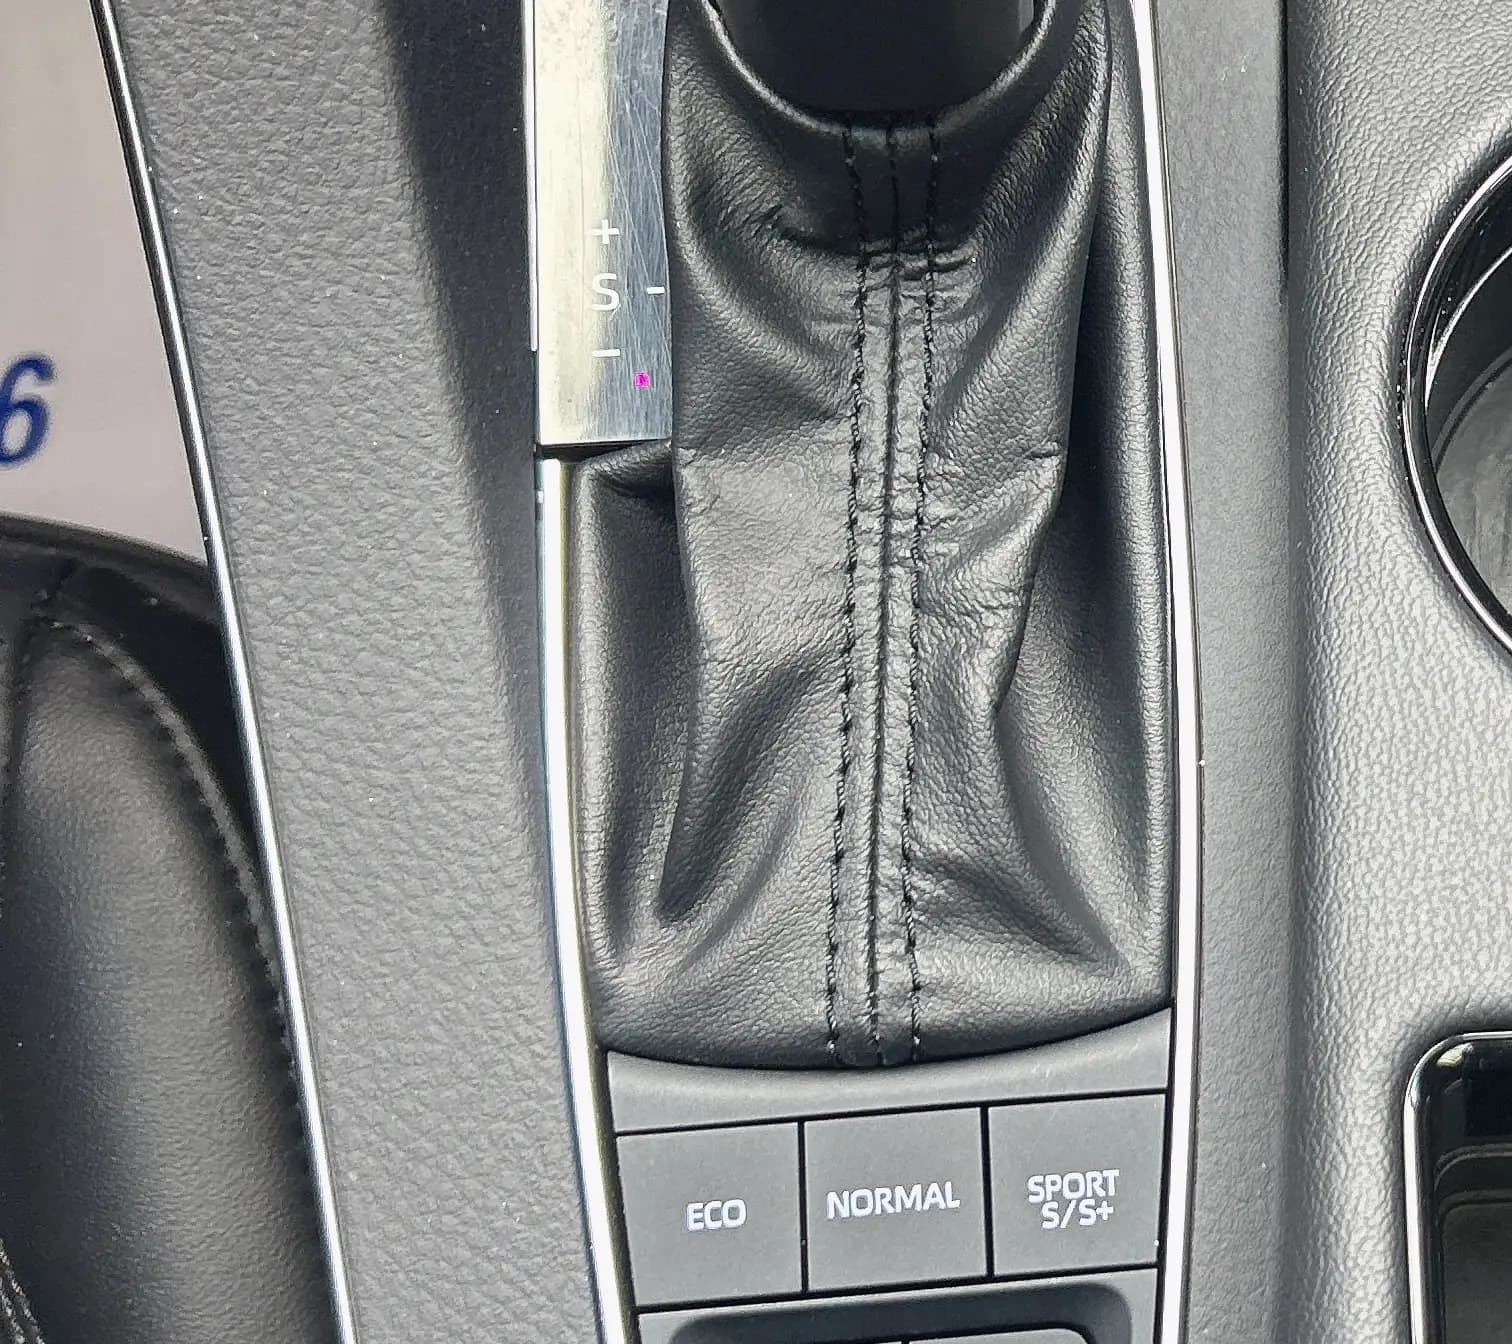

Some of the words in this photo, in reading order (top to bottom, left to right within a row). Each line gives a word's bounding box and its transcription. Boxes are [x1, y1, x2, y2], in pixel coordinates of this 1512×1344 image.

[592, 273, 619, 311] S
[826, 1181, 960, 1219] NORMAL
[1027, 1169, 1120, 1202] SPORT
[687, 1199, 747, 1231] ECO
[1041, 1199, 1114, 1229] S/S+
